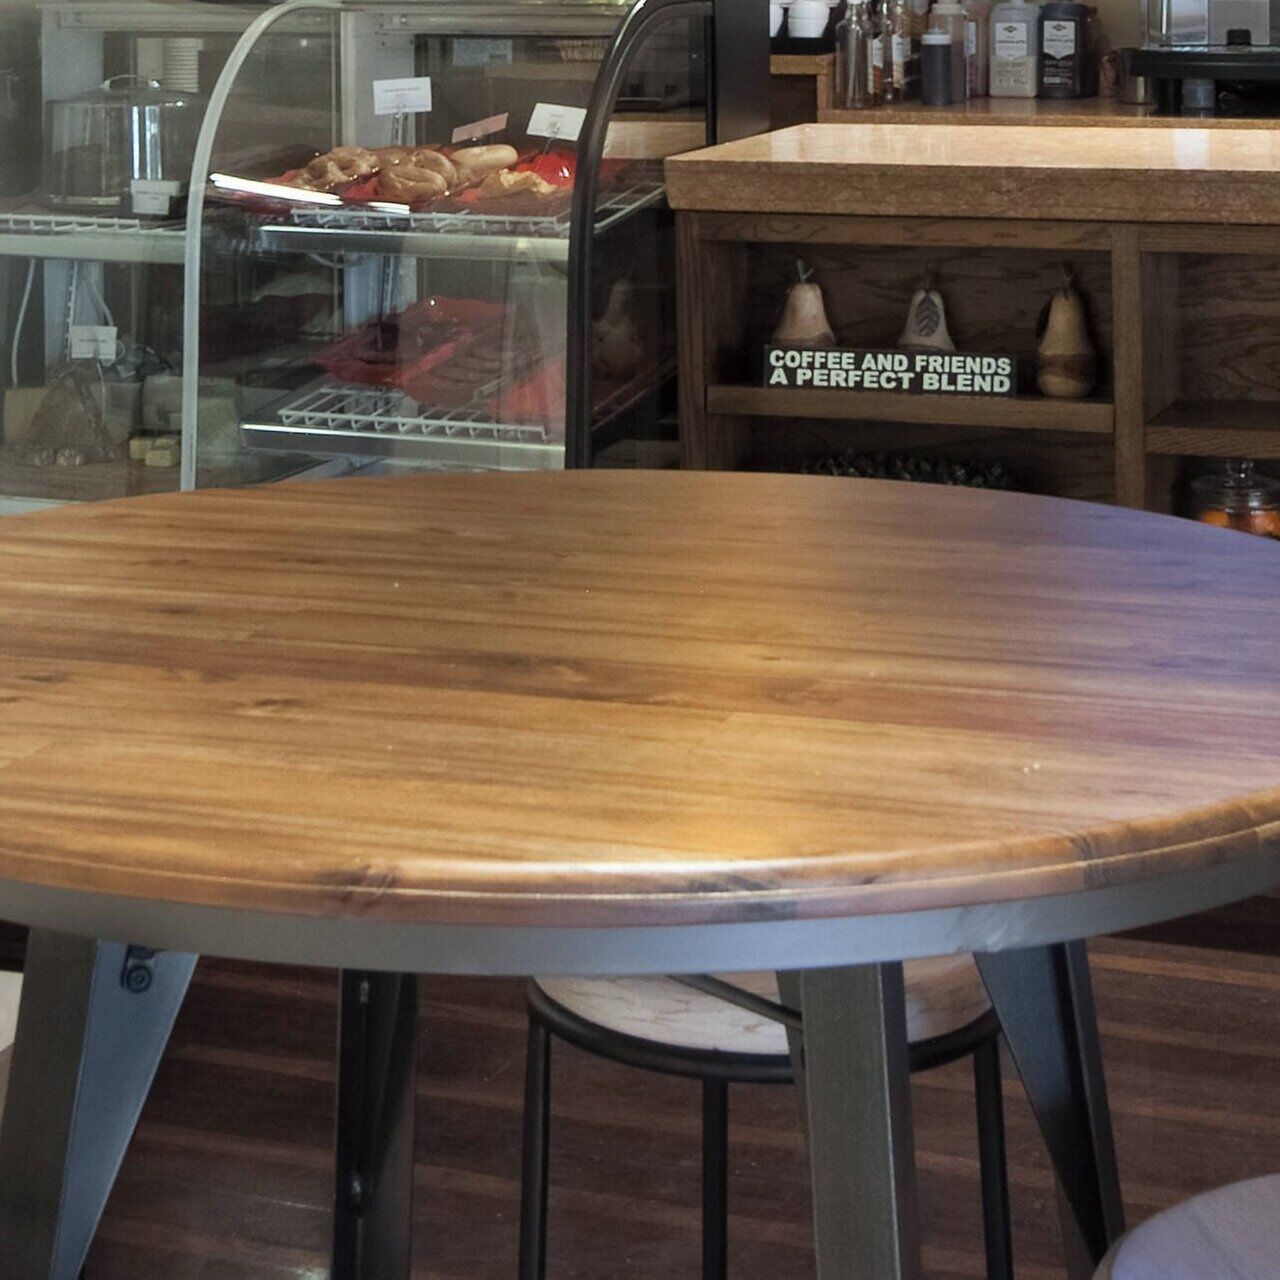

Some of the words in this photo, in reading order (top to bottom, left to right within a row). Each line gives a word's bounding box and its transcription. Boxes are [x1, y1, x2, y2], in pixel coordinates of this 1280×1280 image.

[769, 349, 855, 370] COFFEE
[862, 353, 908, 372] AND
[915, 355, 1011, 375] FRIENDS
[769, 368, 788, 385] A
[796, 369, 914, 390] PERFECT
[923, 373, 1011, 393] BLEND
